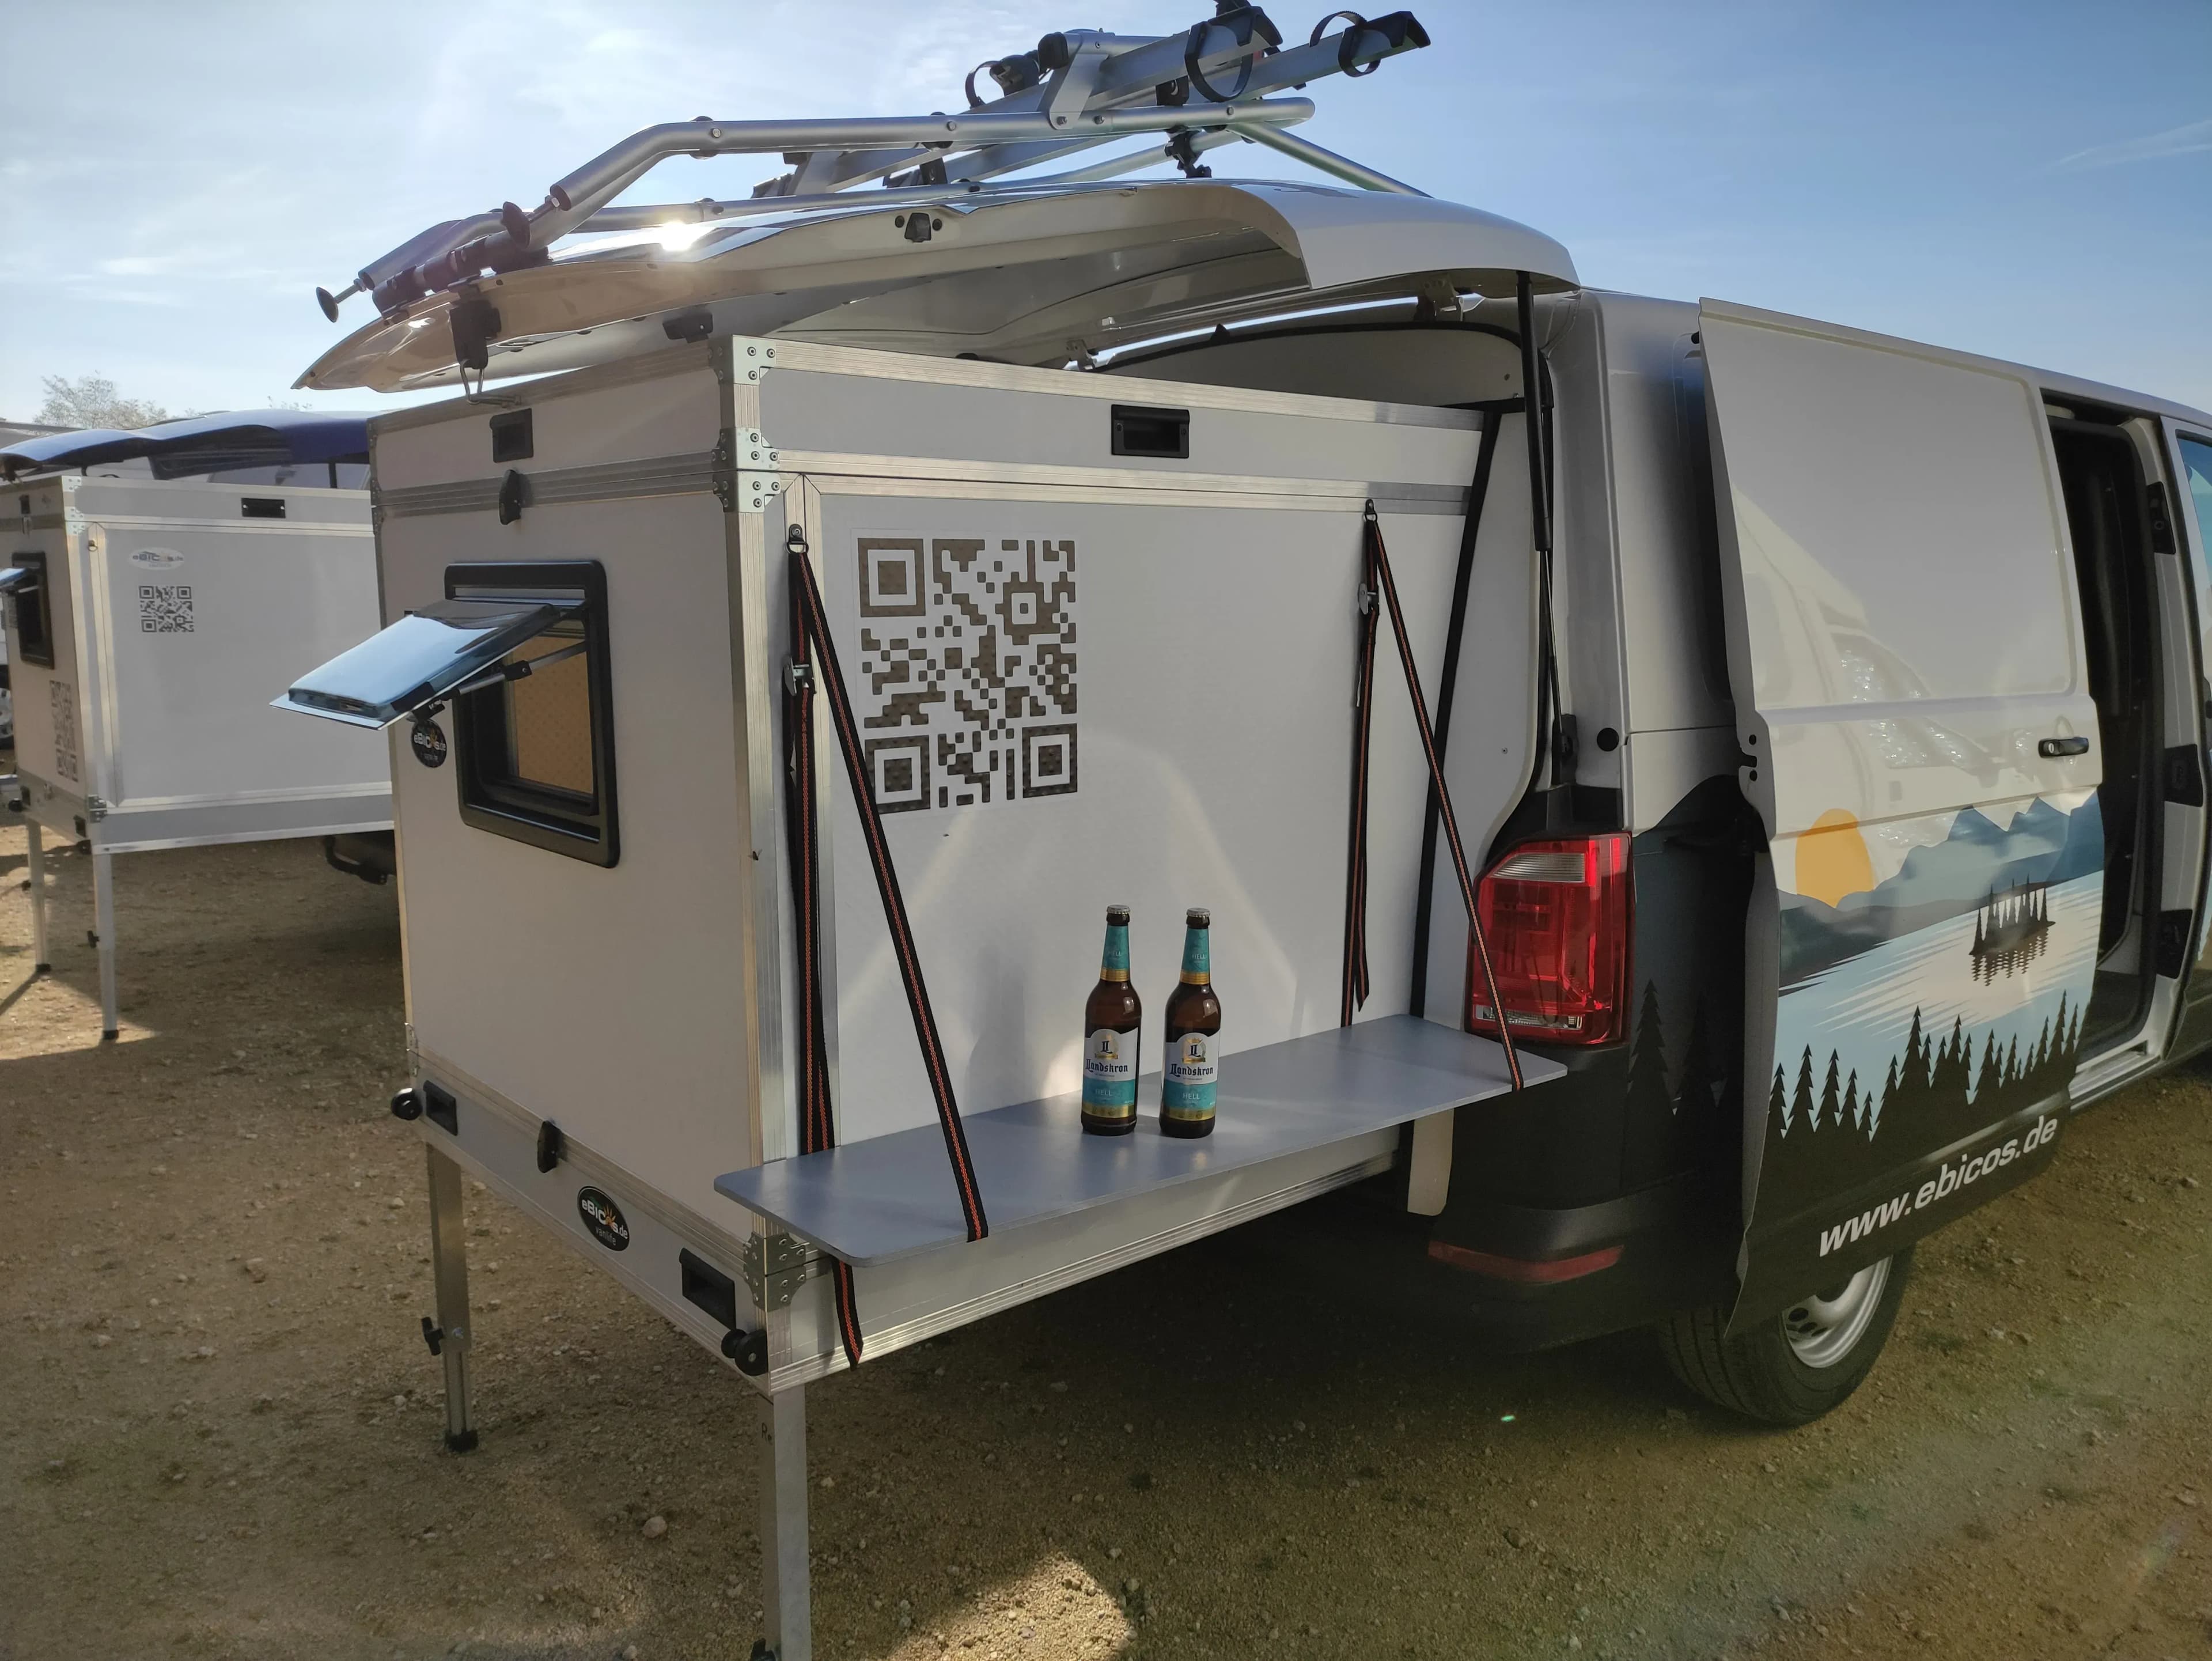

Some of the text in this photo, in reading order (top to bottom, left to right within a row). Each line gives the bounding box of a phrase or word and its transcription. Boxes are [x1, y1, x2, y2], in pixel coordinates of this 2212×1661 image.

[1085, 1058, 1128, 1072] Landskron
[1169, 1064, 1213, 1077] Landskron
[1096, 1089, 1112, 1097] HELL
[1819, 1115, 2058, 1257] www.ebicos.de
